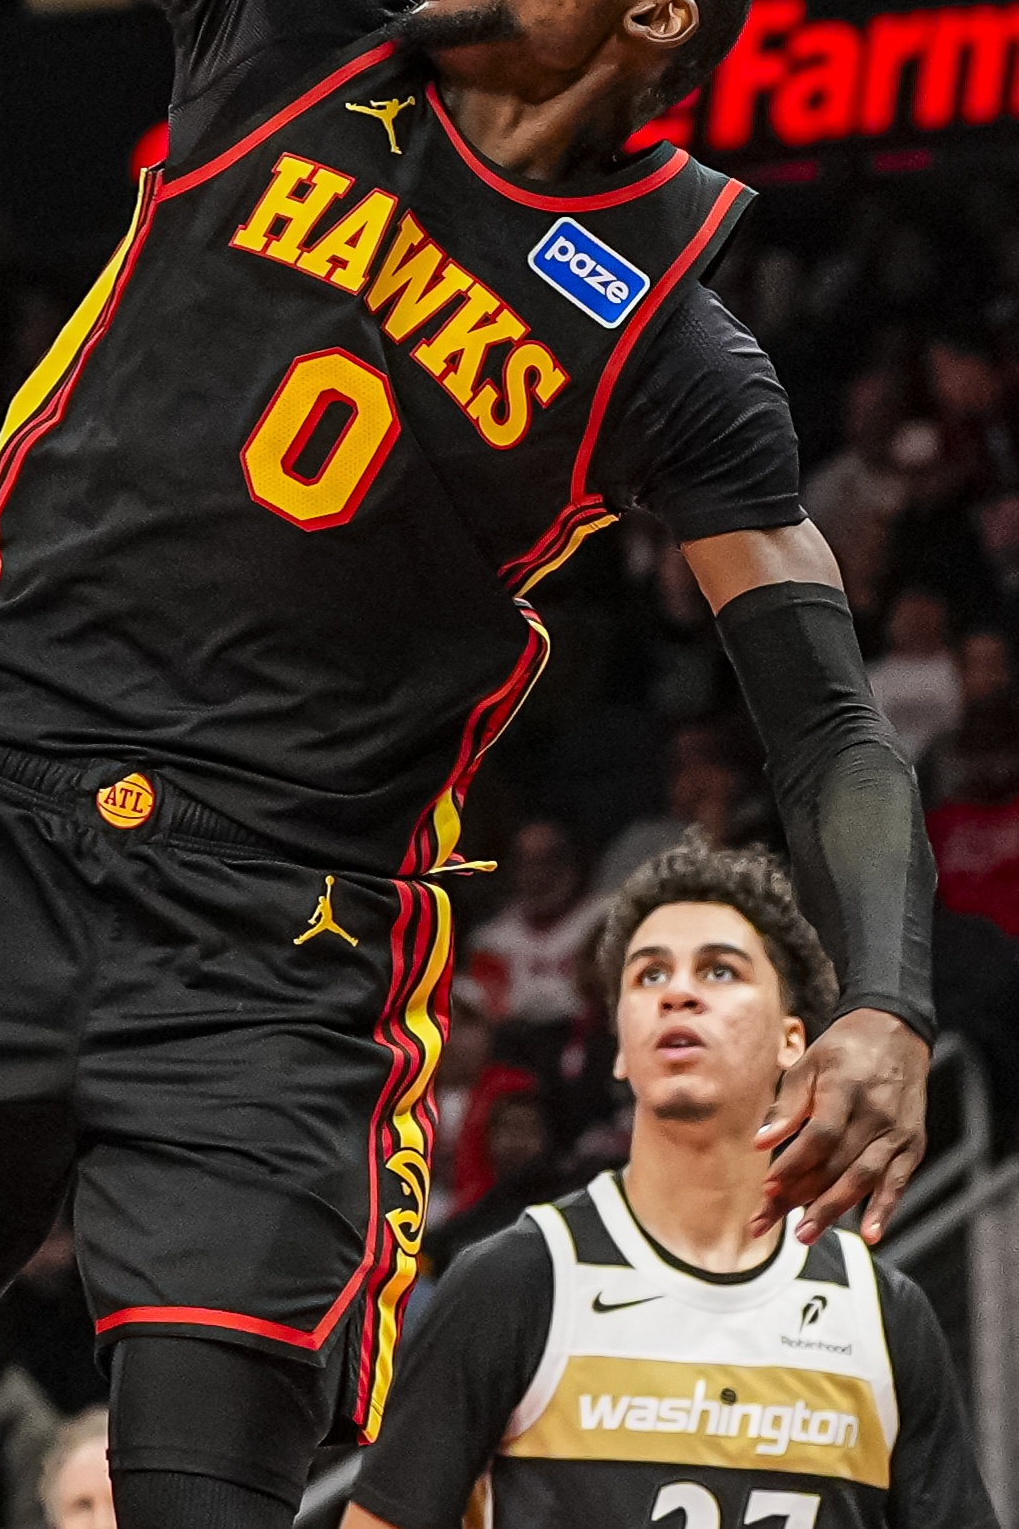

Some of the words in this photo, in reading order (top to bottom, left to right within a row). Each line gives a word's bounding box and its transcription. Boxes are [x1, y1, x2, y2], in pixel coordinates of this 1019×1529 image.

[231, 152, 570, 449] HAWKS
[544, 235, 629, 304] paze
[241, 347, 401, 532] 0
[103, 784, 143, 814] ATL
[579, 1378, 859, 1456] washington
